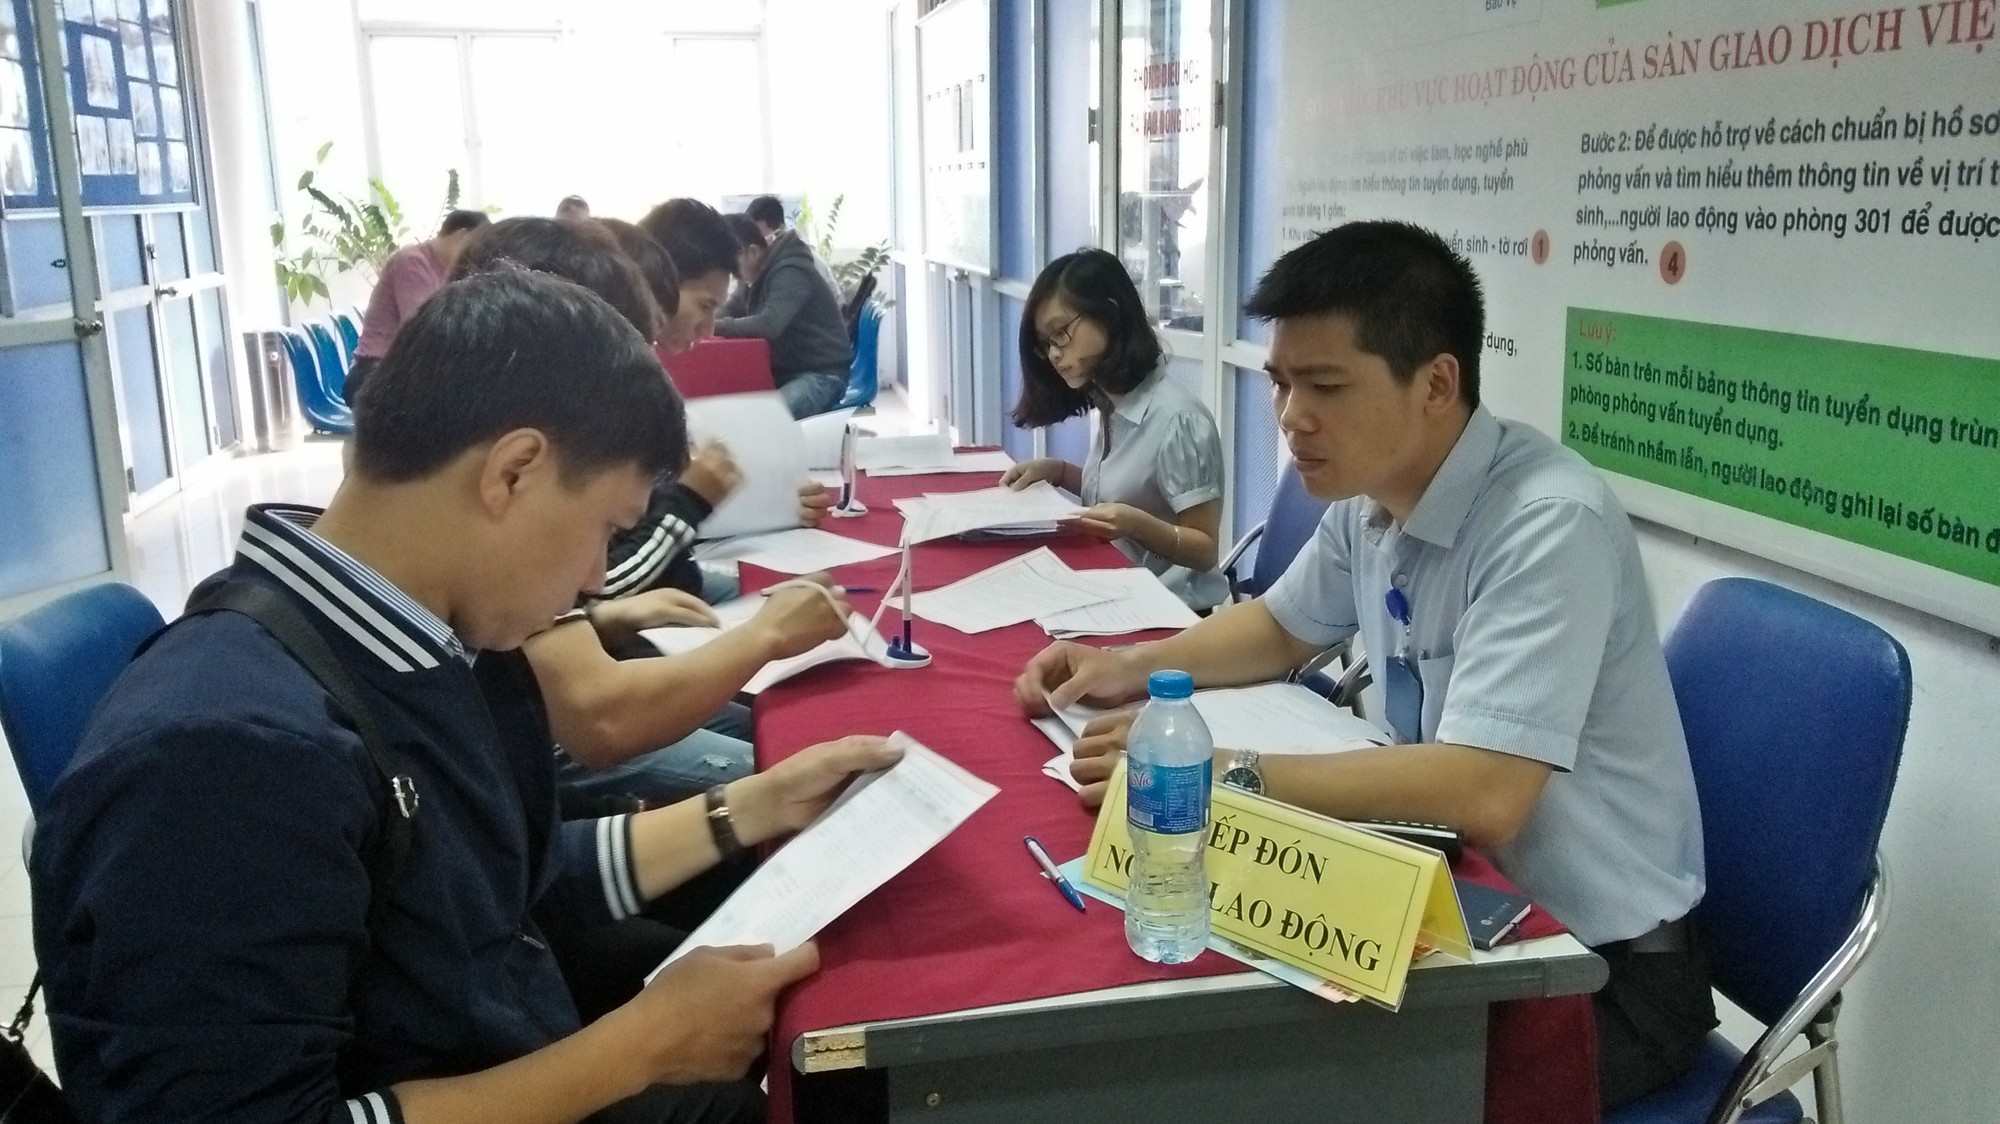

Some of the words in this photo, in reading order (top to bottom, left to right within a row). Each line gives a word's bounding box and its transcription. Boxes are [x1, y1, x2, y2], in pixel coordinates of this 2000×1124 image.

[1454, 68, 1507, 106] HOẠT
[1512, 52, 1576, 103] ĐỘNG
[1584, 36, 1636, 86] CỦA
[1642, 30, 1702, 79] SÀN
[1709, 24, 1792, 72] GIAO
[1801, 6, 1906, 69] DỊCH
[1454, 141, 1473, 163] học
[1506, 137, 1528, 161] phù
[1581, 131, 1615, 154] Bước
[1618, 131, 1631, 152] 2:
[1635, 122, 1656, 151] Để
[1658, 128, 1697, 154] được
[1701, 120, 1722, 148] hỗ
[1726, 124, 1751, 151] trợ
[1755, 116, 1776, 144] về
[1780, 119, 1826, 144] cách
[1832, 106, 1897, 142] chuẩn
[1904, 111, 1926, 144] bị
[1932, 105, 1963, 137] hồ
[1969, 109, 2000, 136] sơ
[1382, 174, 1406, 195] thông
[1409, 175, 1420, 191] tin
[1423, 169, 1449, 195] tuyển
[1452, 173, 1480, 195] dụng,
[1483, 166, 1514, 195] tuyển
[1578, 166, 1621, 195] phỏng
[1626, 164, 1650, 190] vấn
[1655, 166, 1672, 189] và
[1677, 166, 1701, 189] tìm
[1706, 158, 1742, 189] hiểu
[1747, 163, 1792, 189] thêm
[1798, 161, 1857, 193] thông
[1863, 160, 1890, 187] tin
[1898, 155, 1924, 187] về
[1931, 159, 1951, 193] vị
[1957, 157, 1986, 187] trí
[1666, 206, 1690, 228] lao
[1695, 206, 1738, 235] động
[1745, 206, 1777, 229] vào
[1783, 205, 1847, 239] phòng
[1854, 208, 1890, 234] 301
[1901, 201, 1933, 235] để
[1938, 209, 2000, 243] được
[1466, 234, 1488, 253] sinh
[1499, 236, 1510, 254] tờ
[1537, 238, 1545, 258] 1
[1573, 238, 1616, 267] phỏng
[1619, 239, 1649, 264] vấn.
[1667, 251, 1679, 276] 4
[1486, 332, 1517, 356] dụng,
[1570, 384, 1610, 413] phòng
[1612, 391, 1656, 423] phỏng
[1659, 400, 1685, 425] vấn
[1689, 406, 1732, 436] tuyển
[1735, 417, 1783, 451] dụng.
[1572, 351, 1582, 369] 1.
[1586, 351, 1604, 373] Số
[1605, 356, 1630, 380] bàn
[1633, 361, 1661, 384] trên
[1665, 364, 1693, 390] mỗi
[1697, 370, 1737, 404] bảng
[1742, 379, 1792, 414] thông
[1797, 389, 1820, 414] tin
[1825, 393, 1880, 427] tuyển
[1887, 405, 1943, 444] dụng
[1950, 416, 1999, 449] trùn
[1568, 421, 1579, 440] 2.
[1582, 421, 1599, 445] Để
[1601, 429, 1634, 454] tránh
[1637, 439, 1677, 466] nhầm
[1680, 445, 1708, 477] lẫn,
[1711, 461, 1757, 488] người
[1760, 468, 1786, 495] lao
[1790, 477, 1838, 514] động
[1841, 492, 1874, 519] ghi
[1878, 497, 1902, 529] lại
[1906, 507, 1936, 535] số
[1937, 513, 1980, 549] bàn
[1207, 814, 1250, 856] ẾP
[1254, 839, 1329, 885] ĐÓN
[1209, 881, 1273, 929] LAO
[1279, 913, 1382, 972] ĐỘNG
